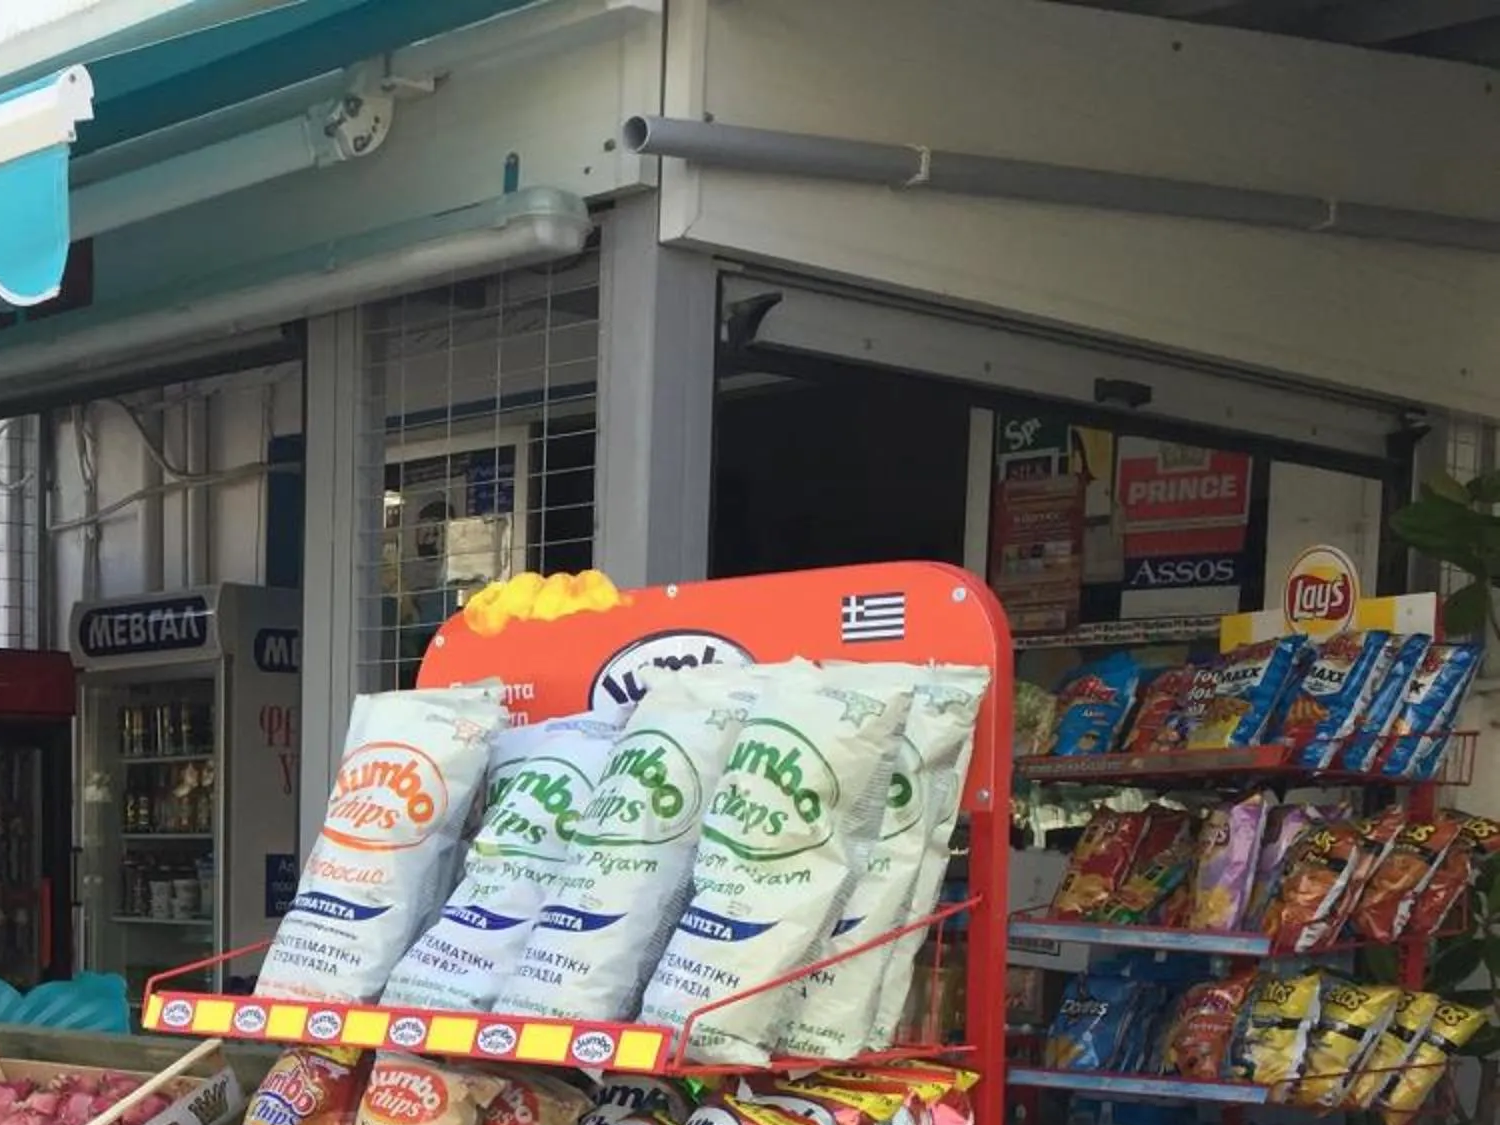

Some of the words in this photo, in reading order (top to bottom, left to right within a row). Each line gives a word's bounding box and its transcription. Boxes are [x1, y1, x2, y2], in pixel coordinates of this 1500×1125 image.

[1127, 474, 1238, 506] PRINCE
[490, 769, 581, 840] umbo
[600, 744, 685, 822] umbo
[488, 803, 548, 845] ips
[259, 1067, 317, 1117] umbo
[367, 1069, 441, 1112] Jumbo
